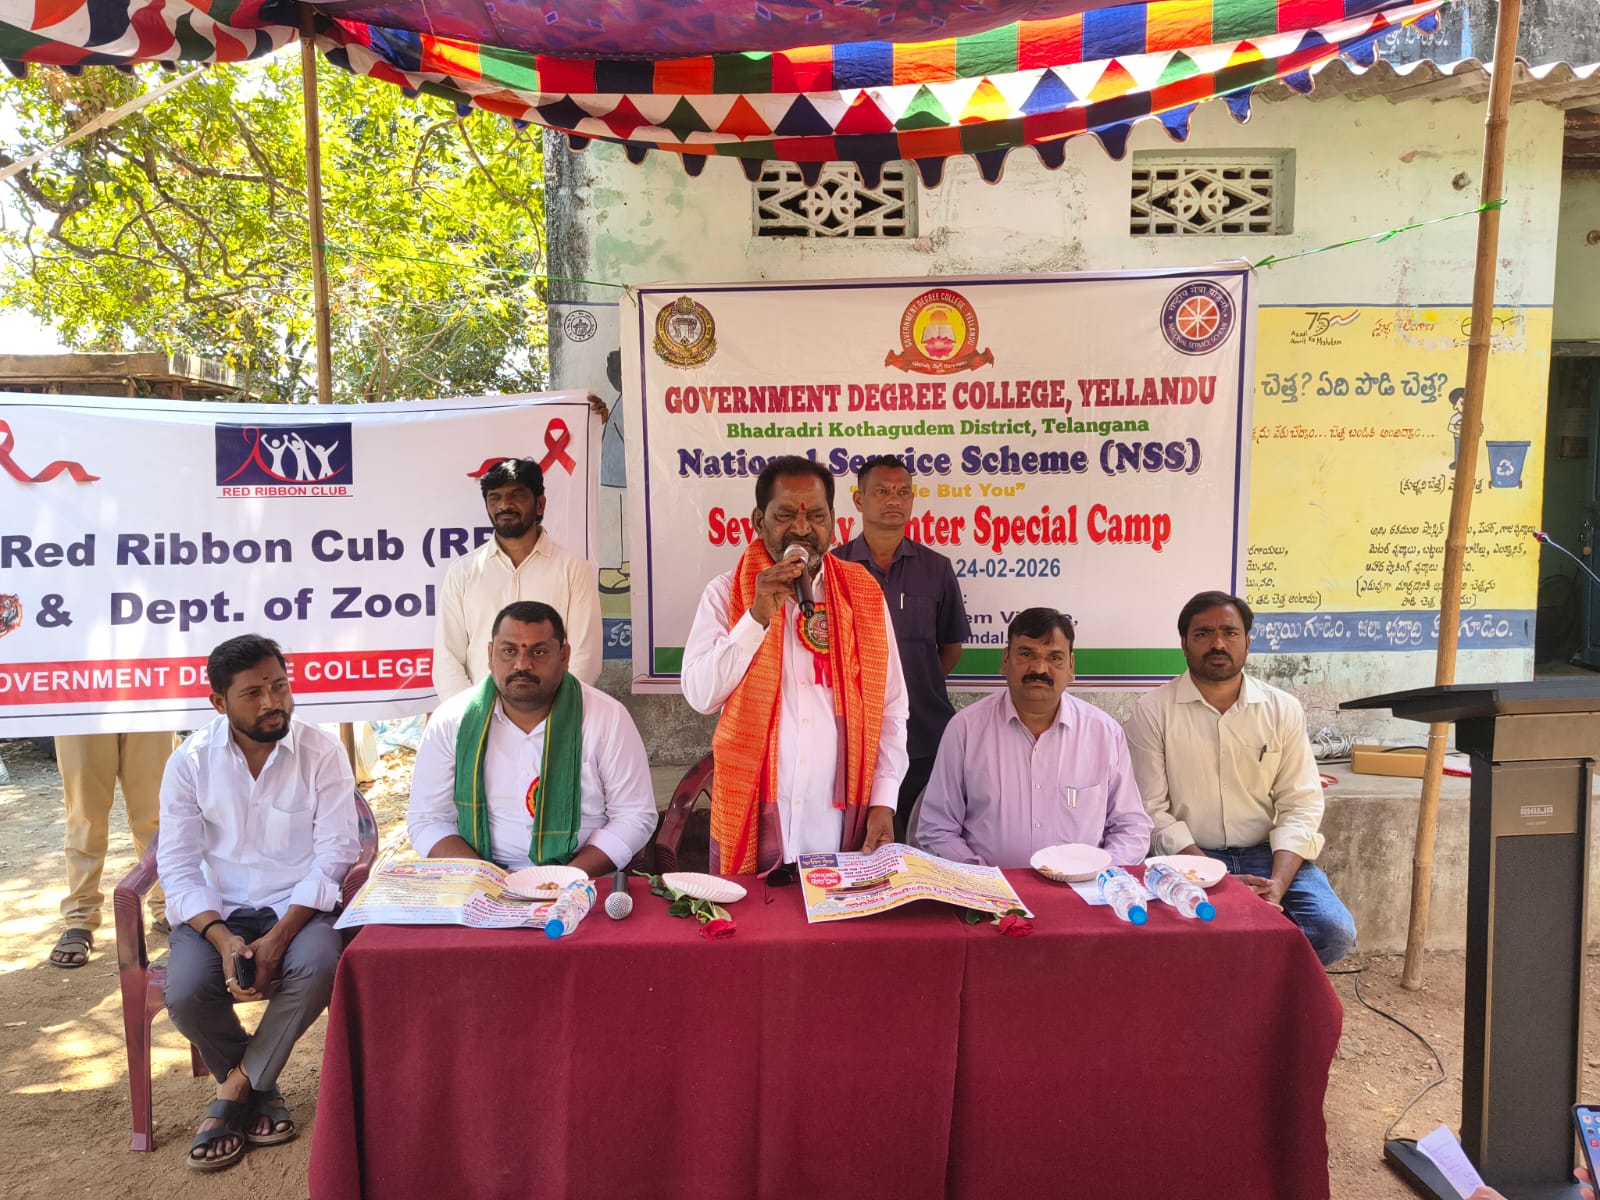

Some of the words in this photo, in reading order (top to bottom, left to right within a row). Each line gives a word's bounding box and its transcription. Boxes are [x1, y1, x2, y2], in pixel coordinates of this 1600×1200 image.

[902, 304, 918, 348] GOVERNMENT
[917, 292, 939, 307] DEGREE
[941, 292, 965, 309] COLLEGE
[665, 384, 842, 414] GOVERNMENT
[847, 382, 947, 413] DEGREE
[952, 379, 1073, 414] COLLEGE,
[1078, 376, 1217, 408] YELLANDU
[1316, 371, 1349, 396] ఏది
[1355, 372, 1395, 396] పొడి
[727, 421, 823, 438] Bhadradri
[828, 419, 955, 440] Kothagudem
[960, 419, 1037, 437] District,
[1041, 418, 1150, 436] Telangana
[677, 448, 817, 478] Natiol
[829, 447, 952, 478] Seice
[961, 444, 1088, 475] Scheme
[1100, 437, 1202, 475] (NSS)
[223, 487, 250, 497] RED
[255, 487, 307, 496] RIBBON
[311, 486, 347, 496] CLUB
[937, 483, 971, 498] But
[708, 507, 754, 546] Sev
[904, 510, 965, 546] nter
[974, 504, 1078, 554] Special
[1087, 503, 1172, 553] Camp
[1, 533, 96, 568] Red
[116, 532, 293, 566] Ribbon
[311, 529, 405, 562] Cub
[956, 558, 1061, 578] 24-02-2026
[36, 594, 73, 628] &
[111, 591, 244, 632] Dept.
[264, 588, 313, 621] of
[331, 585, 436, 619] Zool
[304, 656, 431, 682] COLLEGE
